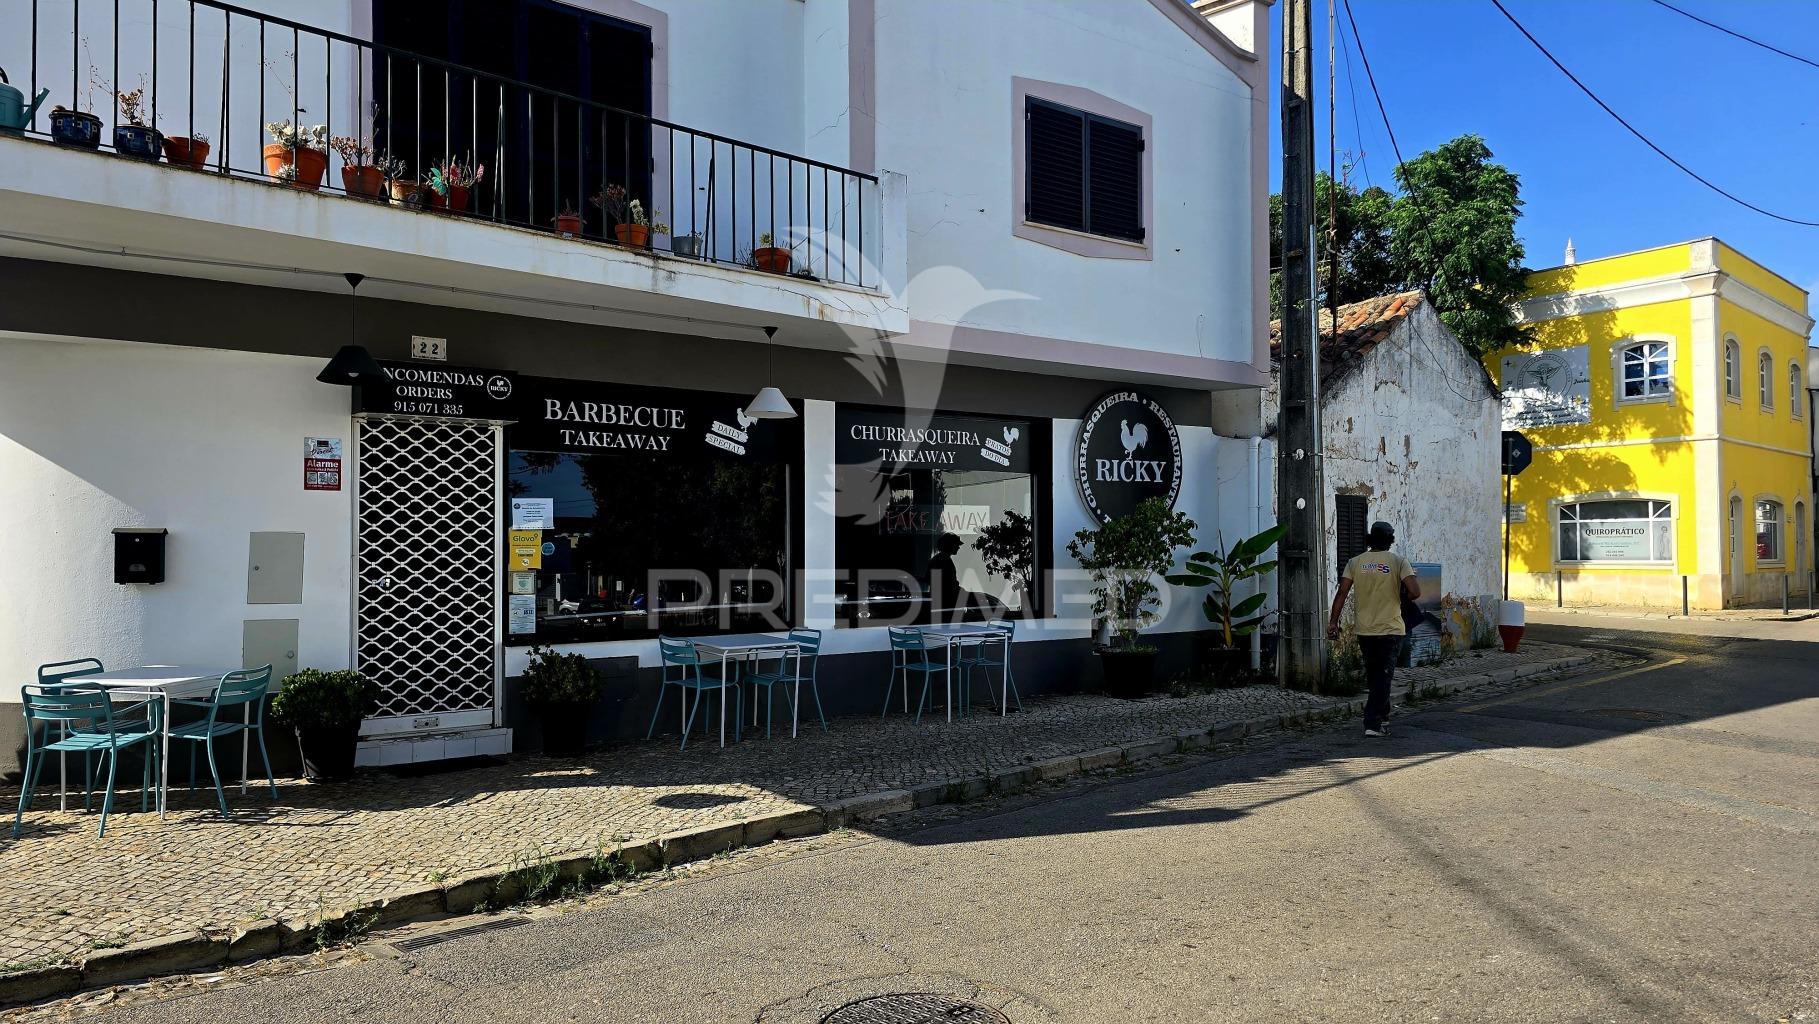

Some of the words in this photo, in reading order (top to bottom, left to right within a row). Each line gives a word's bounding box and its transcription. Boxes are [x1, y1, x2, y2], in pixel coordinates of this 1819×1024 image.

[383, 367, 483, 386] NCOMENDAS
[396, 385, 452, 399] ORDERS
[394, 401, 415, 412] 915
[418, 402, 438, 413] 071
[442, 404, 463, 415] 335
[544, 399, 685, 429] BARBECUE
[560, 429, 670, 450] TAKEAWAY
[718, 424, 742, 439] DAILY
[851, 425, 980, 446] CHURRASQUEIRA
[708, 435, 741, 453] SPECIAL
[987, 439, 1010, 454] PRATOS
[1079, 391, 1139, 508] CHURRASQUEIRA
[307, 460, 339, 468] Alarme
[879, 449, 956, 464] TAKEAWAY
[1149, 401, 1182, 510] RESTAURANTE
[1095, 458, 1167, 483] RICKY
[936, 511, 987, 530] AWAY
[1585, 527, 1645, 536] QUIROPRÁTICO
